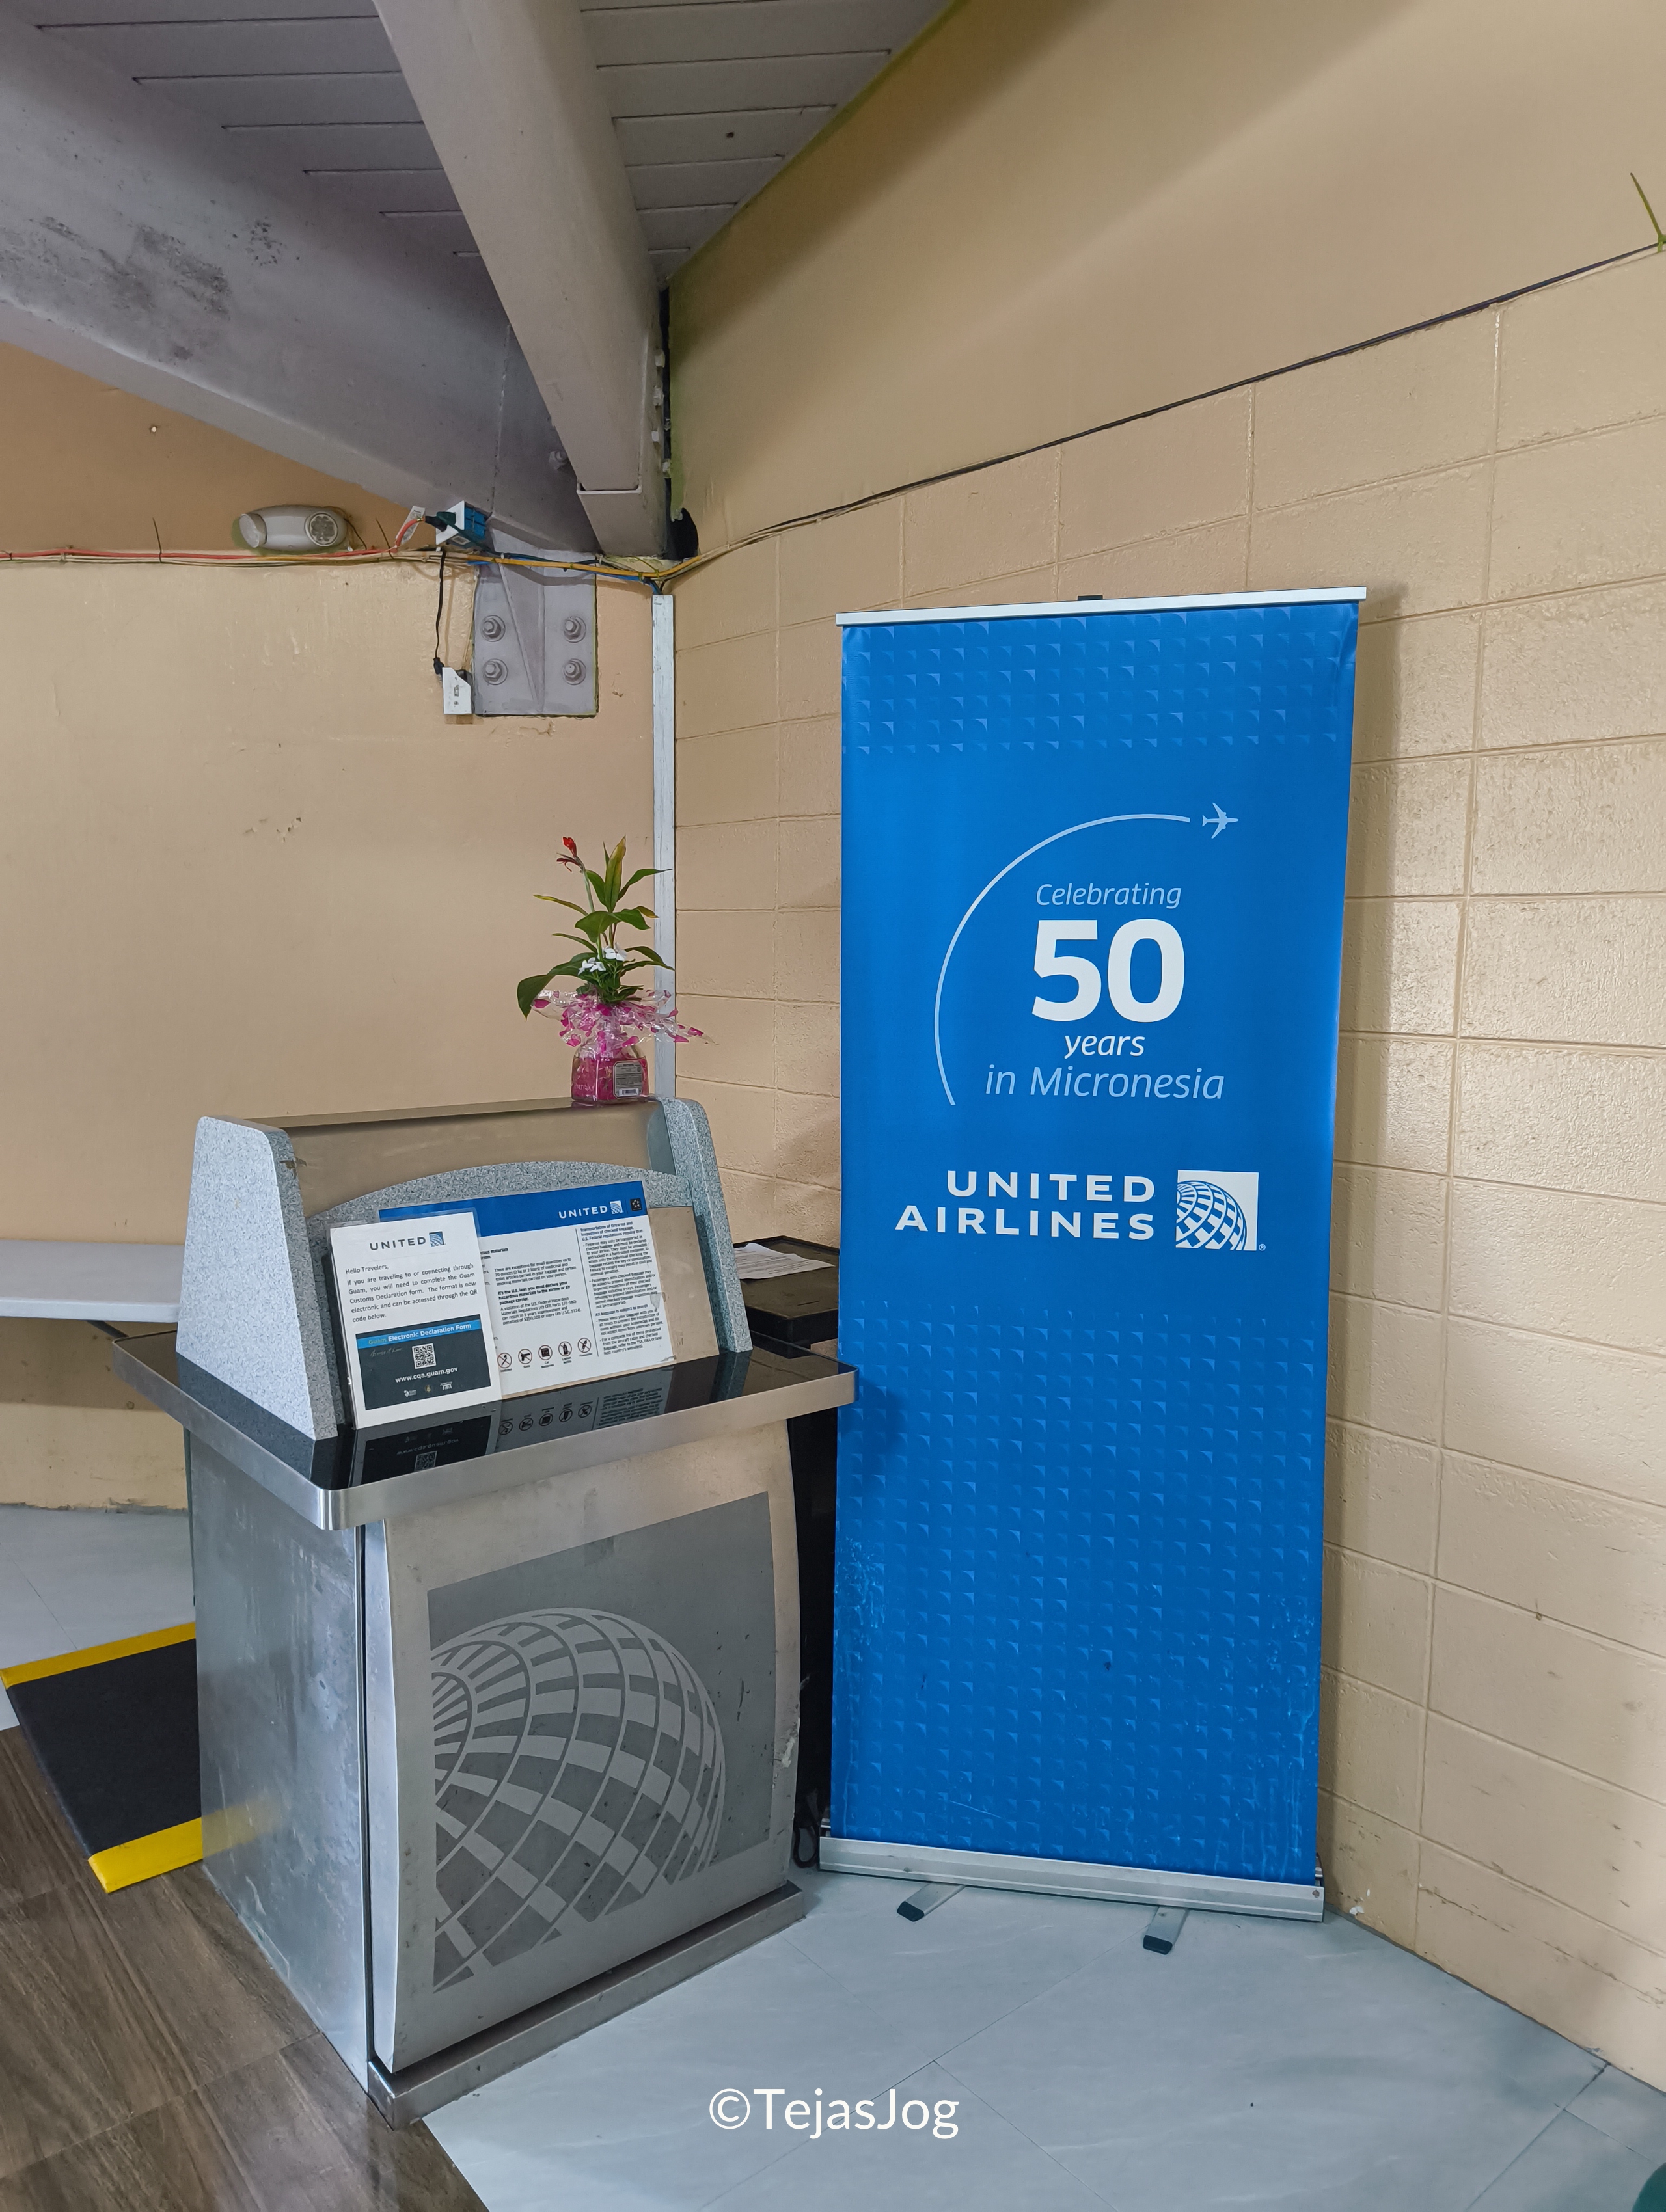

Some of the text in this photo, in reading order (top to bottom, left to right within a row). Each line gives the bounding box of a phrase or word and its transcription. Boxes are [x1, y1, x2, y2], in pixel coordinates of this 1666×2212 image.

[1036, 883, 1181, 909] Celebrating
[1032, 918, 1184, 1023] 50
[1064, 1034, 1145, 1059] years
[985, 1064, 1225, 1099] in Micronesia
[947, 1170, 1155, 1202] UNITED
[558, 1206, 608, 1219] UNITED
[895, 1205, 1154, 1241] AIRLINES
[369, 1236, 426, 1251] UNITED
[351, 1304, 379, 1313] electronic
[412, 1295, 436, 1304] accessed
[376, 1291, 407, 1300] Declaration
[388, 1332, 418, 1342] Electronic
[420, 1327, 454, 1336] Declaration
[395, 1368, 457, 1382] www.cqa.guam.gov
